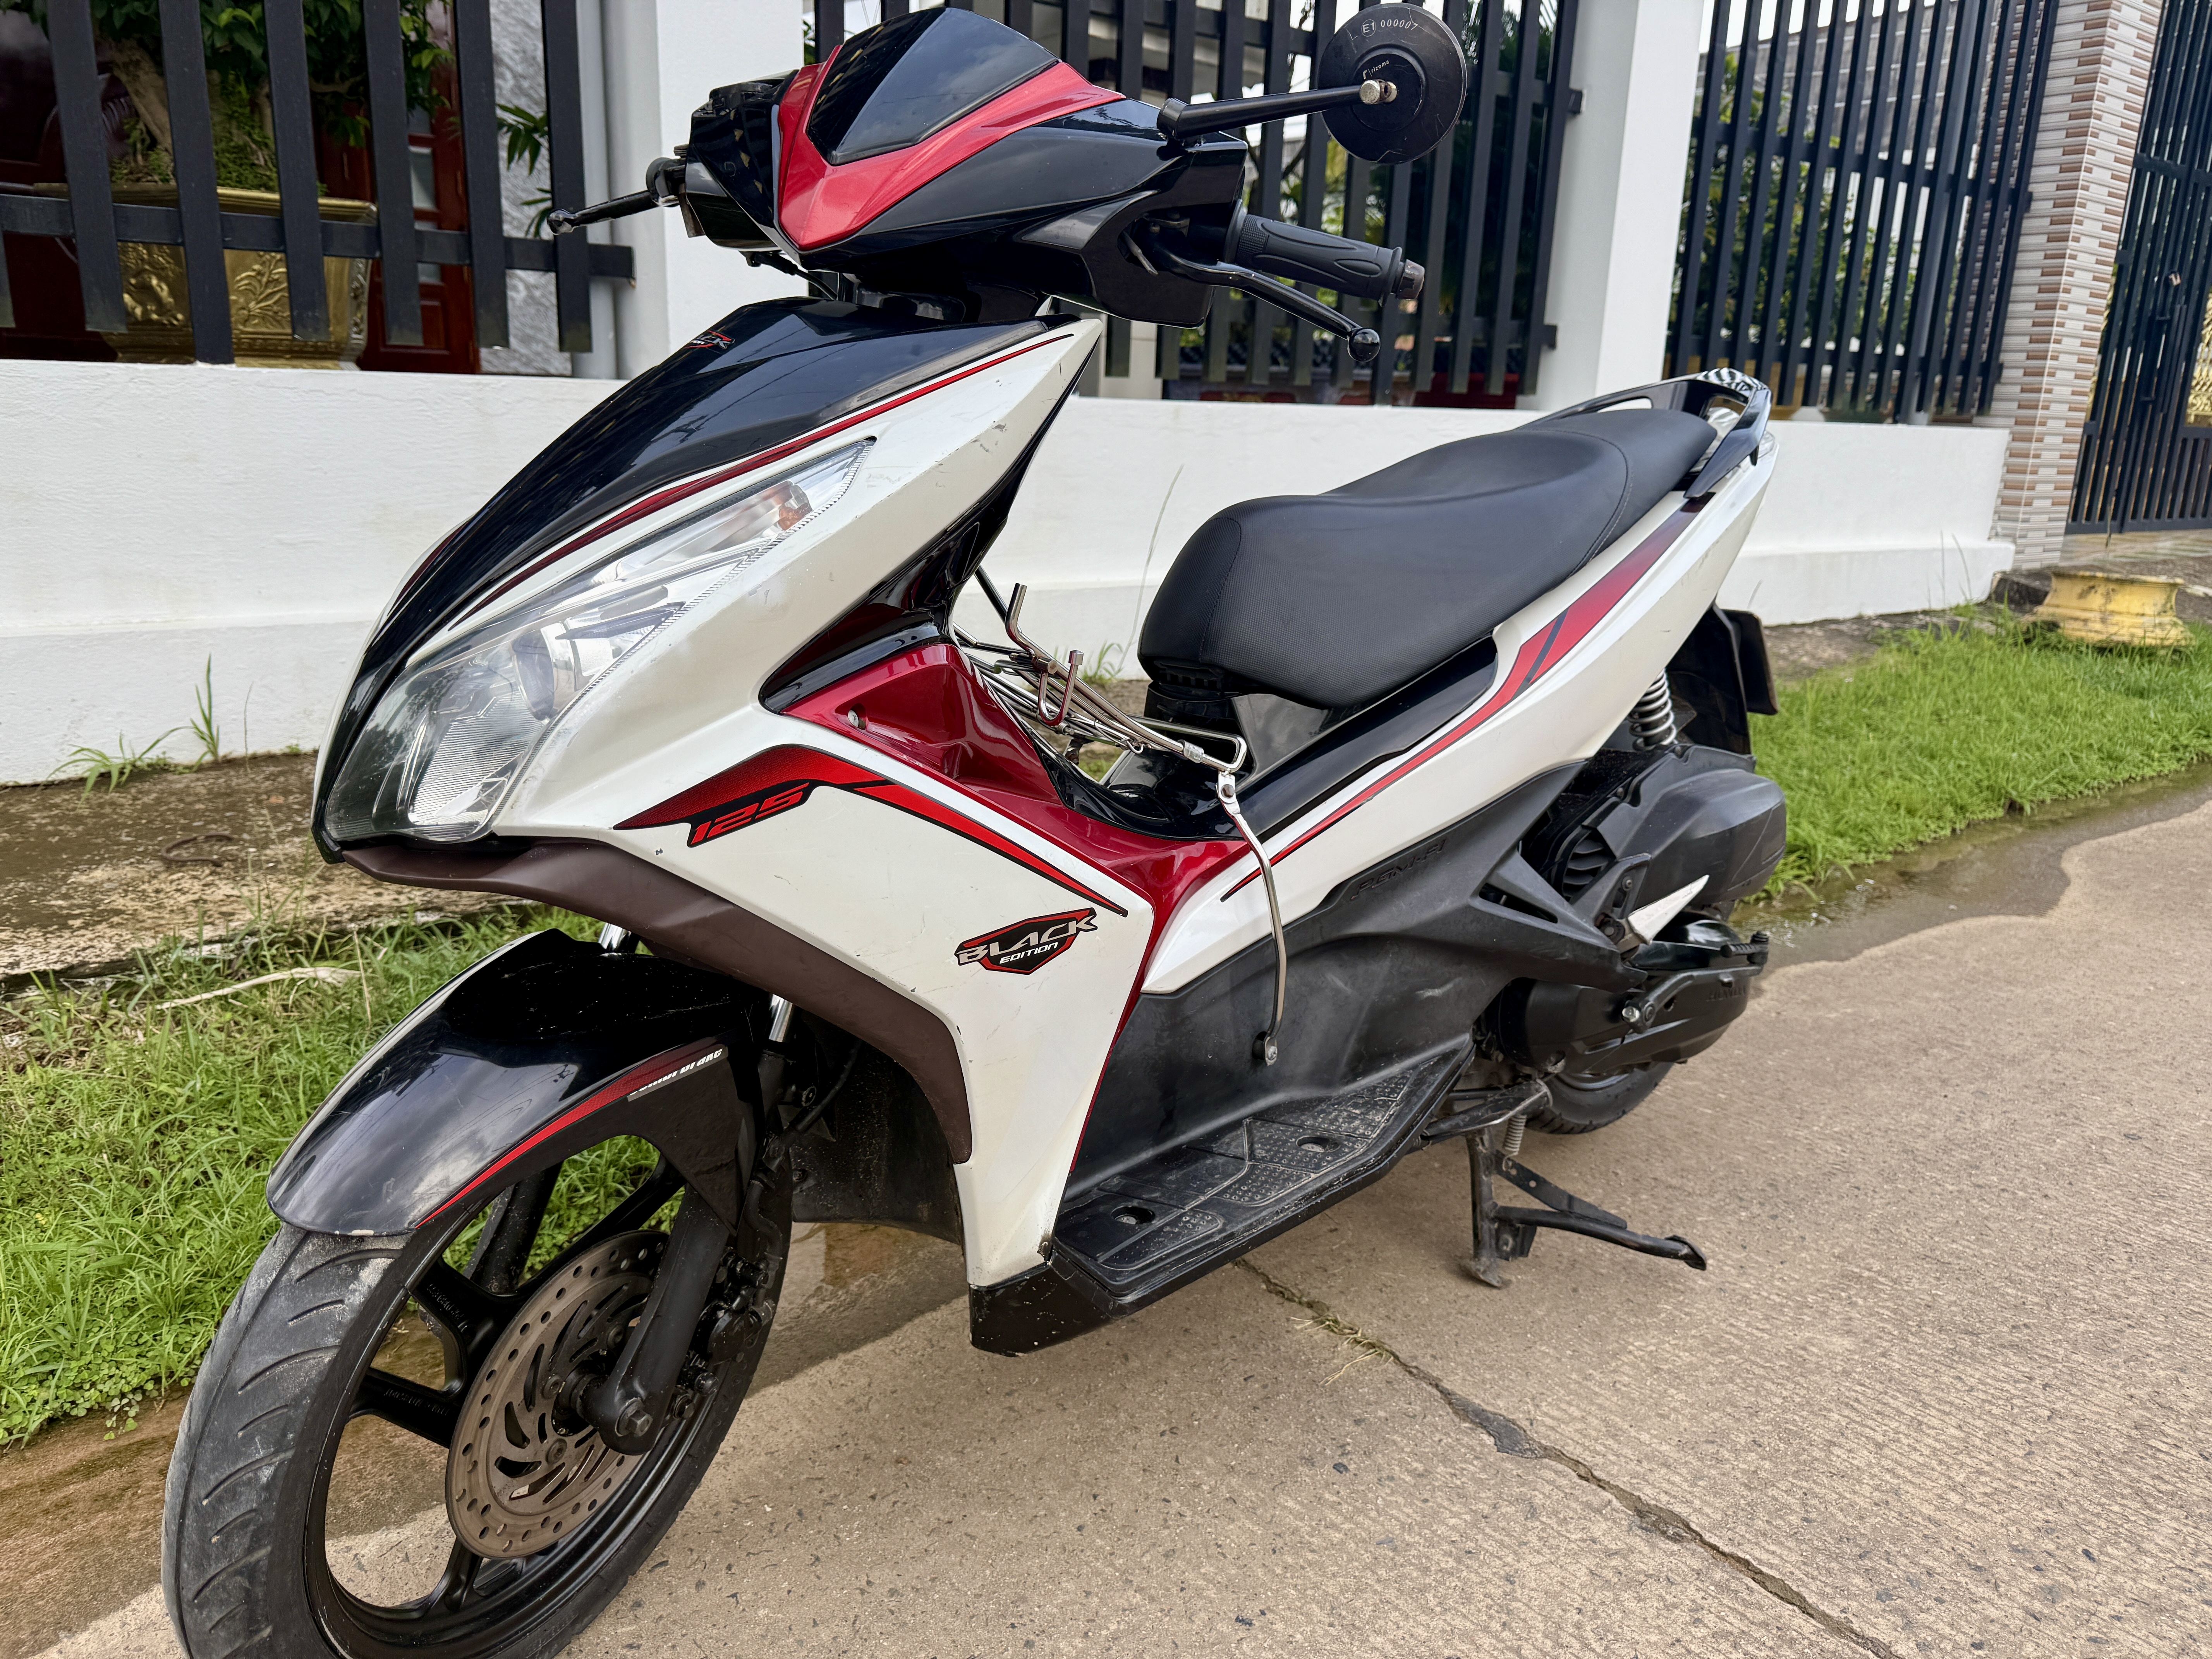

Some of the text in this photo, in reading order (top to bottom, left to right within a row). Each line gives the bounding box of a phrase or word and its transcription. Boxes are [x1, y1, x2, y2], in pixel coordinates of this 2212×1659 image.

[1362, 19, 1418, 34] E1 000007
[1371, 60, 1389, 73] rizoma
[690, 782, 809, 845] 125
[956, 915, 1096, 964] BLACK
[999, 942, 1058, 964] EDITION
